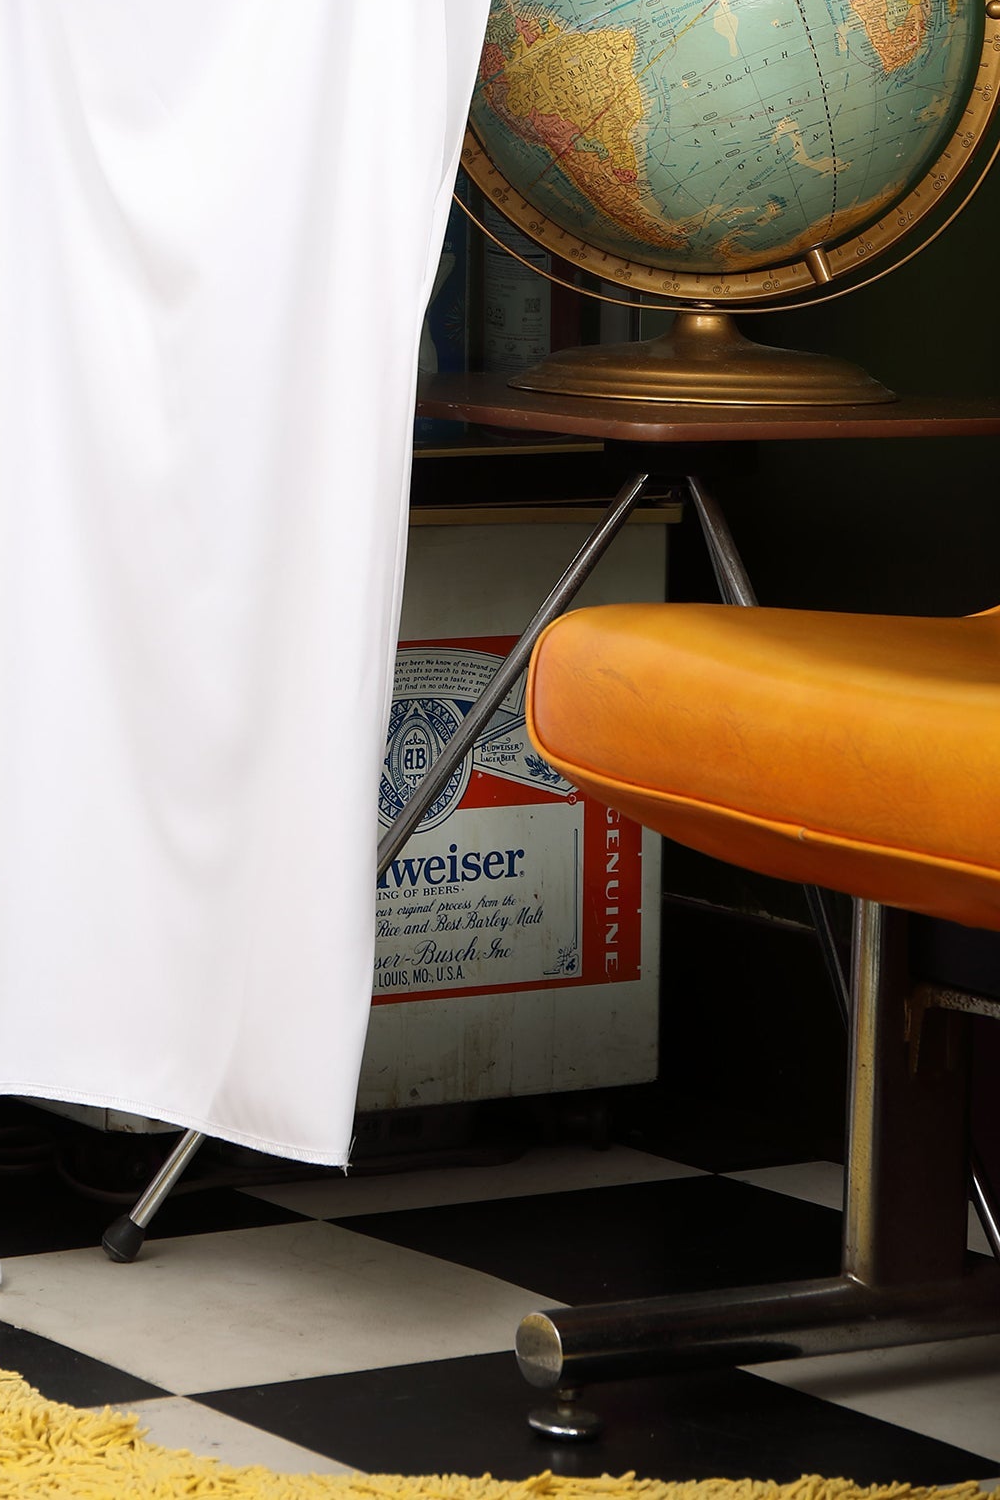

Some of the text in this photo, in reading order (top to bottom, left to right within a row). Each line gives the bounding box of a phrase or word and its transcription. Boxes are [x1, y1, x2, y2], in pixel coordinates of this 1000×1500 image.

[377, 844, 525, 889] weiser
[404, 889, 418, 897] OF
[423, 885, 460, 896] BEERS
[605, 807, 620, 973] GENUINE
[397, 899, 436, 919] original
[437, 901, 472, 913] process
[476, 895, 498, 910] from
[502, 894, 517, 906] the
[376, 905, 543, 938] Rice and Best Barley Malt
[379, 970, 410, 988] LOUIS,
[437, 965, 465, 980] U.S.A.
